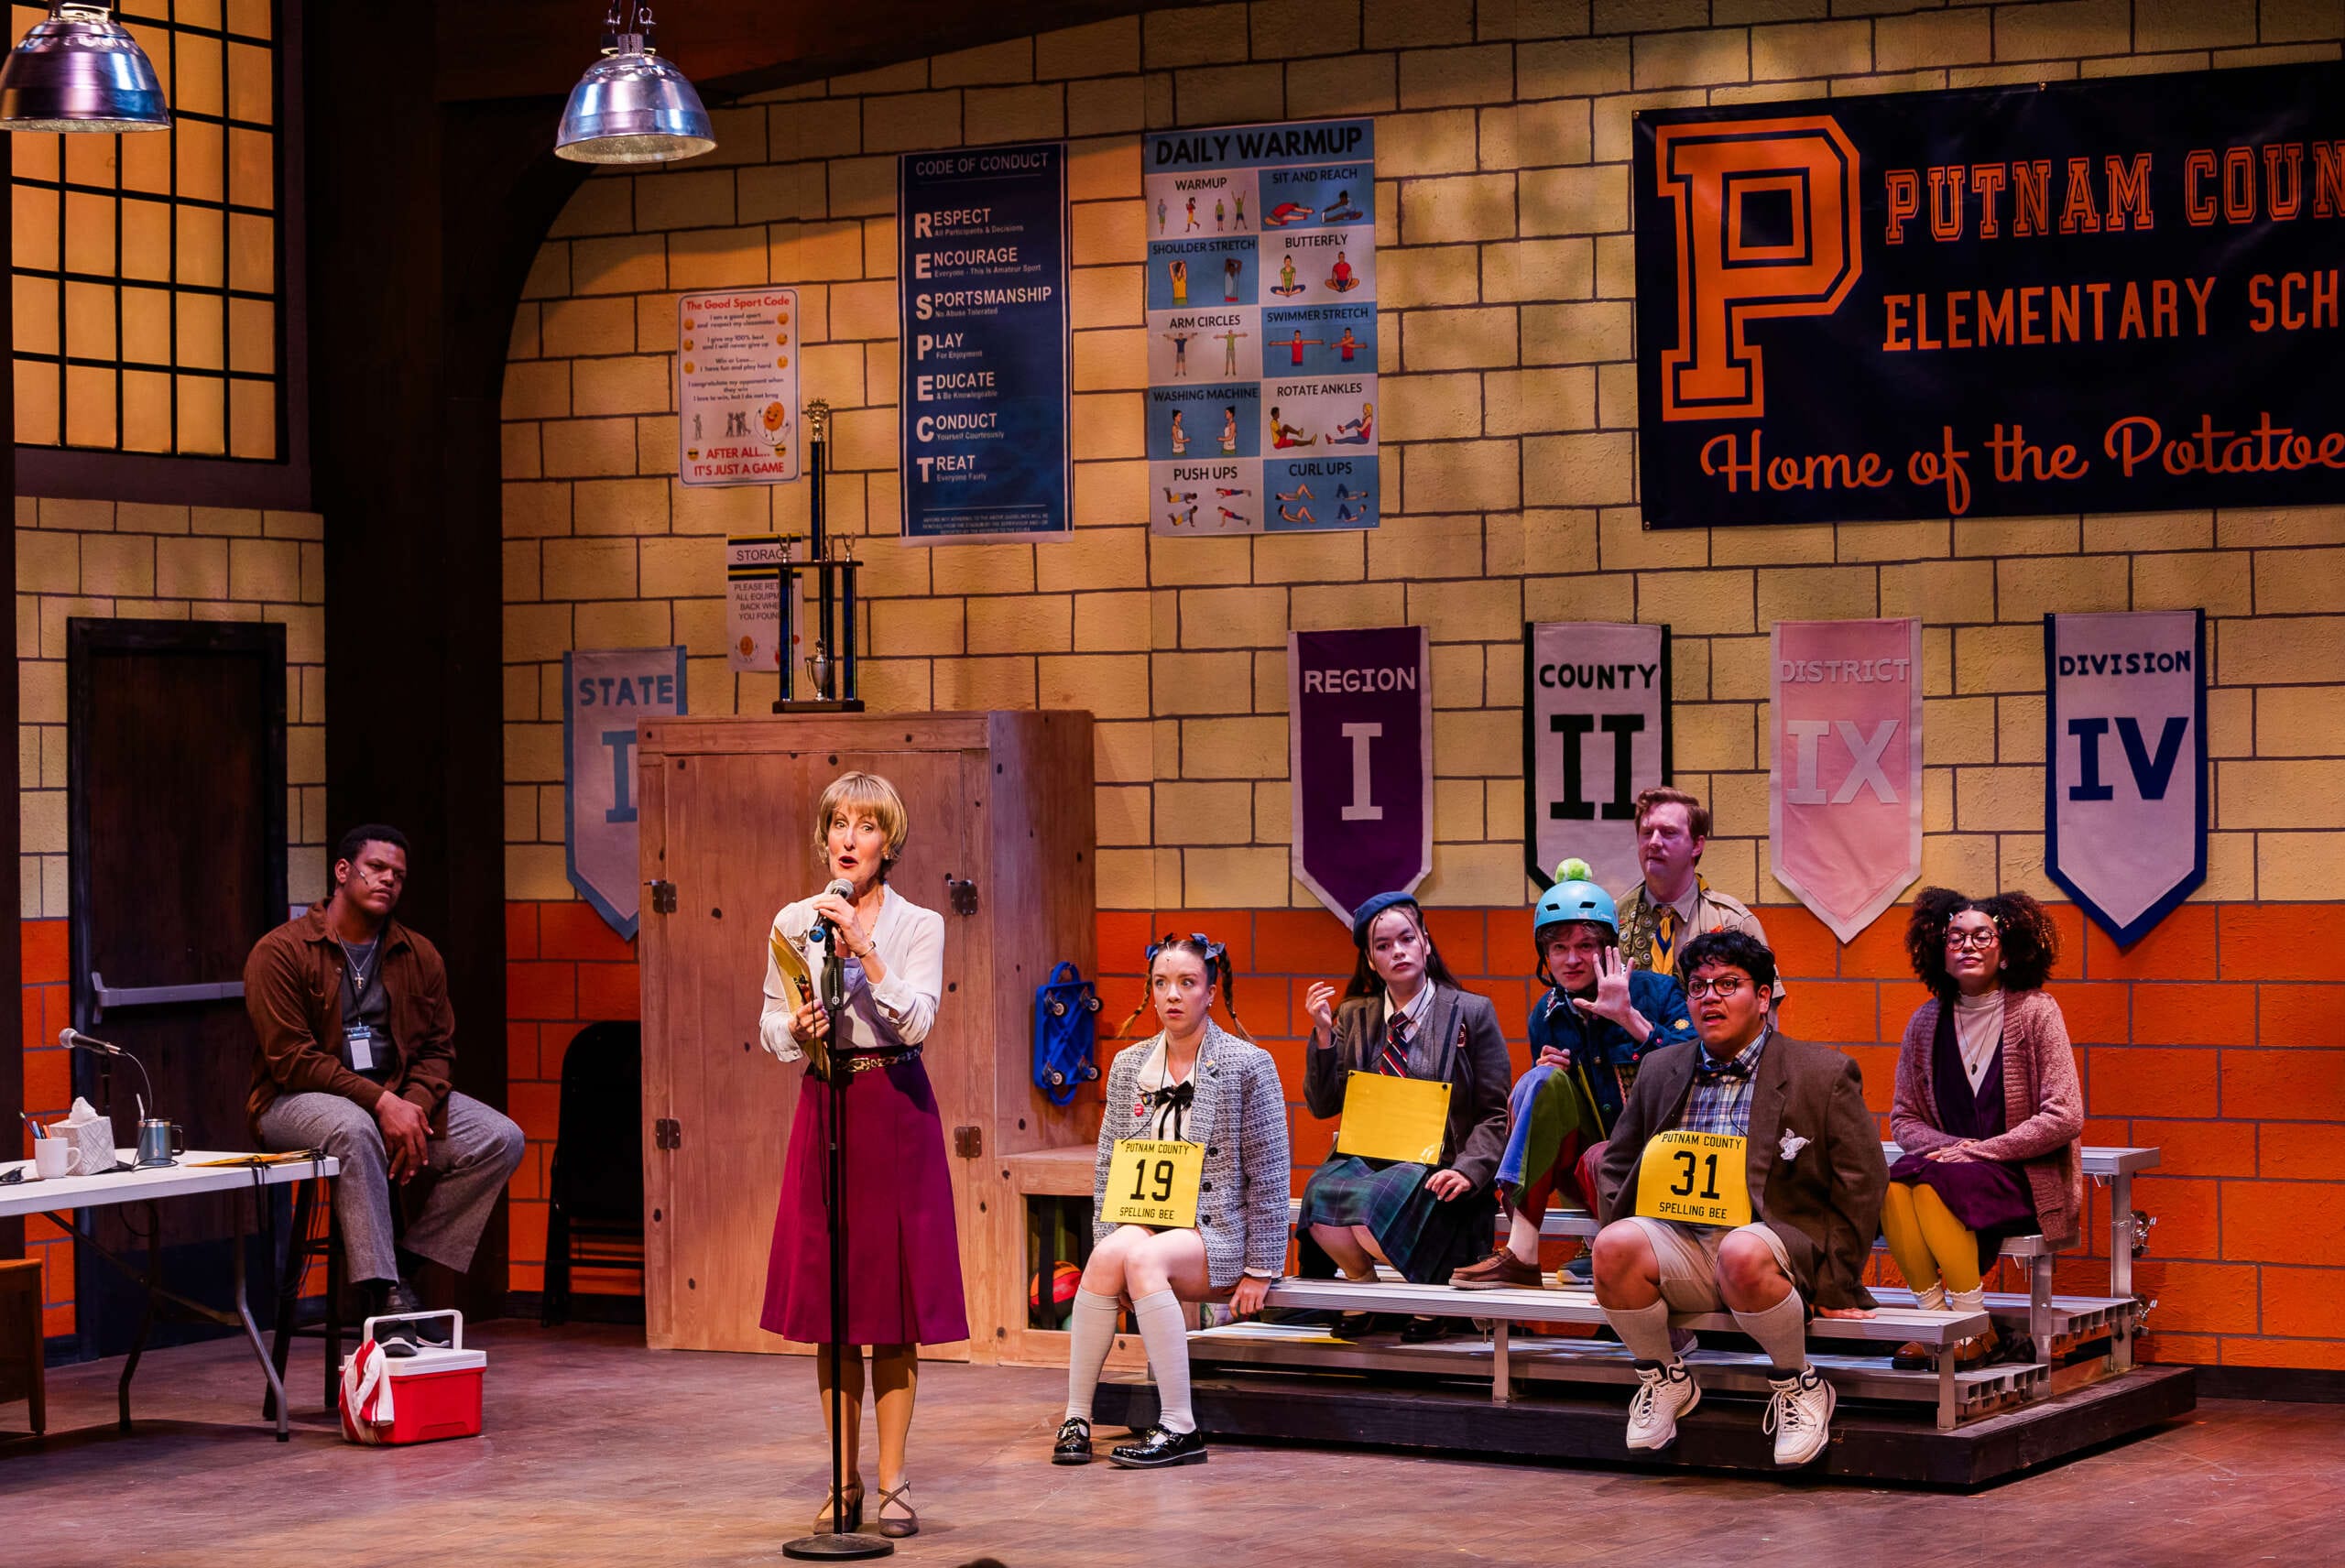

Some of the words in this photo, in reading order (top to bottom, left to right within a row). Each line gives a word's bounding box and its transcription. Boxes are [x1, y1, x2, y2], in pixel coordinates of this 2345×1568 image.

[1156, 136, 1230, 165] DAILY
[1238, 126, 1362, 159] WARMUP
[916, 159, 954, 176] CODE
[958, 158, 976, 173] OF
[980, 152, 1048, 170] CONDUCT
[1272, 171, 1290, 183] SIT
[1292, 170, 1318, 182] AND
[1320, 169, 1358, 180] REACH
[1175, 177, 1227, 191] WARMUP
[1885, 152, 2154, 245] PUTNAM
[2184, 139, 2345, 226] COUN
[915, 208, 991, 238] RESPECT
[1152, 242, 1206, 255] SHOULDER
[1209, 239, 1256, 252] STRETCH
[1285, 234, 1348, 248] BUTTERFLY
[915, 247, 1018, 279] ENCOURAGE
[1656, 114, 1861, 422] P
[687, 300, 702, 310] The
[704, 299, 731, 310] Good
[734, 298, 761, 310] Sport
[764, 295, 790, 306] Code
[916, 286, 1052, 321] SPORTSMANSHIP
[1268, 310, 1320, 322] SWIMMER
[1324, 308, 1369, 320] STRETCH
[1882, 277, 2217, 352] ELEMENTARY
[2250, 269, 2338, 332] SCH
[1170, 317, 1194, 329] ARM
[1197, 315, 1240, 327] CIRCLES
[917, 332, 964, 361] PLAY
[917, 372, 995, 401] EDUCATE
[1153, 389, 1204, 402] WASHING
[1207, 387, 1259, 399] MACHINE
[1277, 385, 1318, 397] ROTATE
[1321, 382, 1362, 395] ANKLES
[917, 412, 998, 442] CONDUCT
[706, 448, 739, 459] AFTER
[741, 446, 770, 458] ALL...
[694, 465, 713, 476] IT'S
[714, 463, 739, 475] JUST
[742, 463, 750, 474] A
[752, 462, 784, 474] GAME
[917, 455, 975, 483] TREAT
[1173, 467, 1209, 481] PUSH
[1213, 466, 1238, 479] UPS
[1289, 463, 1324, 476] CURL
[1326, 462, 1352, 475] UPS
[1701, 428, 1893, 494] Home
[1908, 425, 1970, 516] of
[1984, 423, 2089, 484] the
[756, 612, 778, 620] FOUN
[1781, 659, 1910, 683] DISTRICT
[2059, 649, 2191, 676] DIVISION
[1304, 667, 1415, 693] REGION
[1539, 664, 1657, 689] COUNTY
[579, 675, 673, 706] STATE
[1550, 713, 1645, 820] II
[1786, 720, 1900, 805] IX
[2068, 717, 2189, 800] IV
[1341, 723, 1383, 821] I
[1126, 1143, 1154, 1153] PUTNAM
[1158, 1144, 1189, 1155] COUNTY
[1662, 1133, 1699, 1145] PUTNAM
[1704, 1136, 1741, 1149] COUNTY
[1130, 1159, 1173, 1202] 19
[1671, 1150, 1720, 1200] 31
[1119, 1206, 1155, 1218] SPELLING
[1159, 1209, 1174, 1220] BEE
[1659, 1202, 1704, 1216] SPELLING
[1708, 1207, 1727, 1219] BEE
